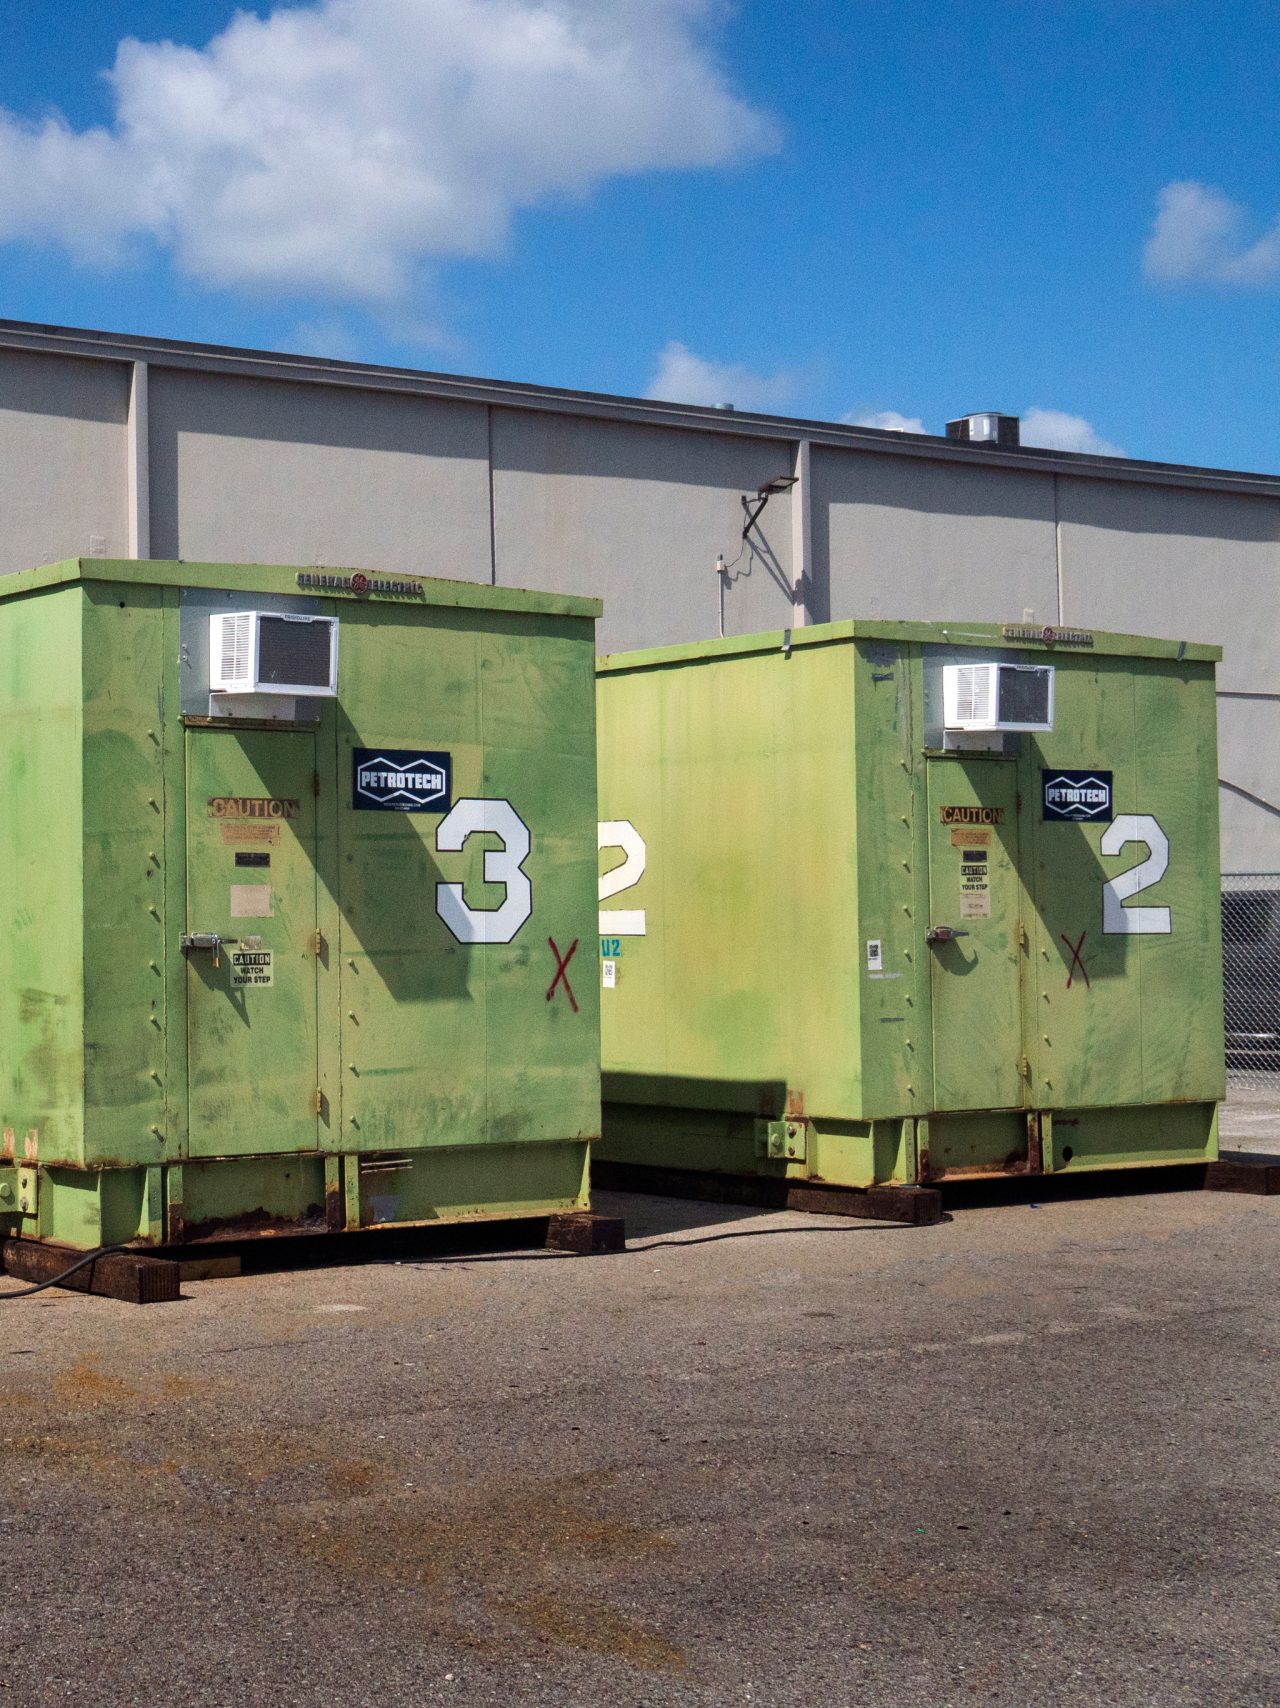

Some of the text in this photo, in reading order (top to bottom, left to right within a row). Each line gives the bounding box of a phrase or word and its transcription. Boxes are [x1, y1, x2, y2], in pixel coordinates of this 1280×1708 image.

[361, 771, 442, 790] PETROTECH
[1048, 788, 1106, 803] PETROTECH
[212, 799, 295, 817] CAUTION
[943, 807, 1001, 823] CAUTION
[435, 797, 532, 945] 3
[597, 819, 647, 936] 2
[961, 865, 987, 875] CAUTION
[1100, 813, 1172, 935] 2
[601, 939, 621, 957] U2
[232, 953, 271, 965] CAUTION
[240, 967, 264, 975] WATCH
[233, 976, 253, 984] YOUR
